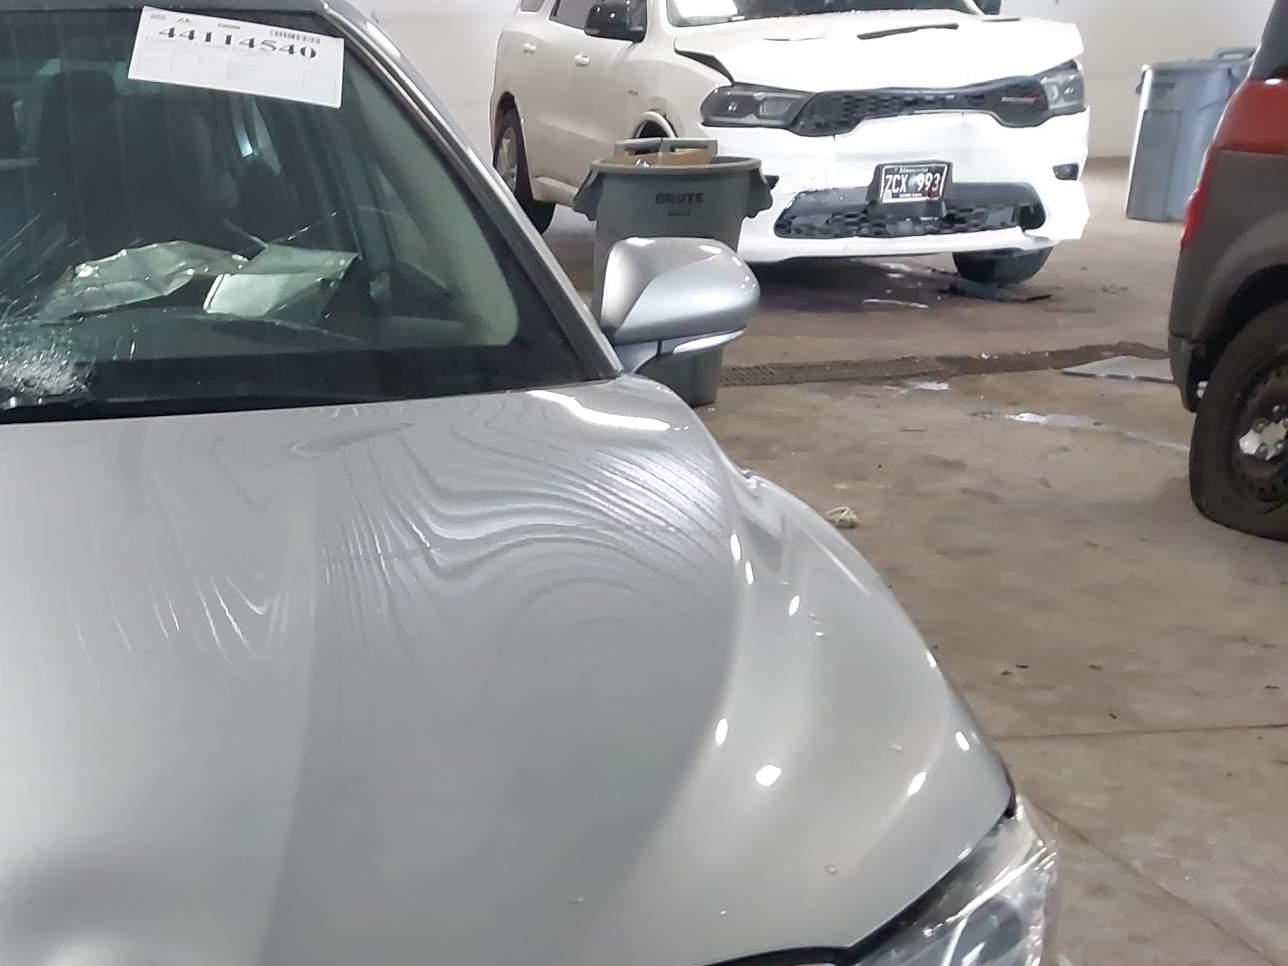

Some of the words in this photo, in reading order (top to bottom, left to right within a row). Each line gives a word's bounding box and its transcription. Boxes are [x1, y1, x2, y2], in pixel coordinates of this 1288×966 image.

[159, 26, 317, 59] 44114540
[885, 174, 908, 193] ZCX
[916, 172, 941, 192] 993
